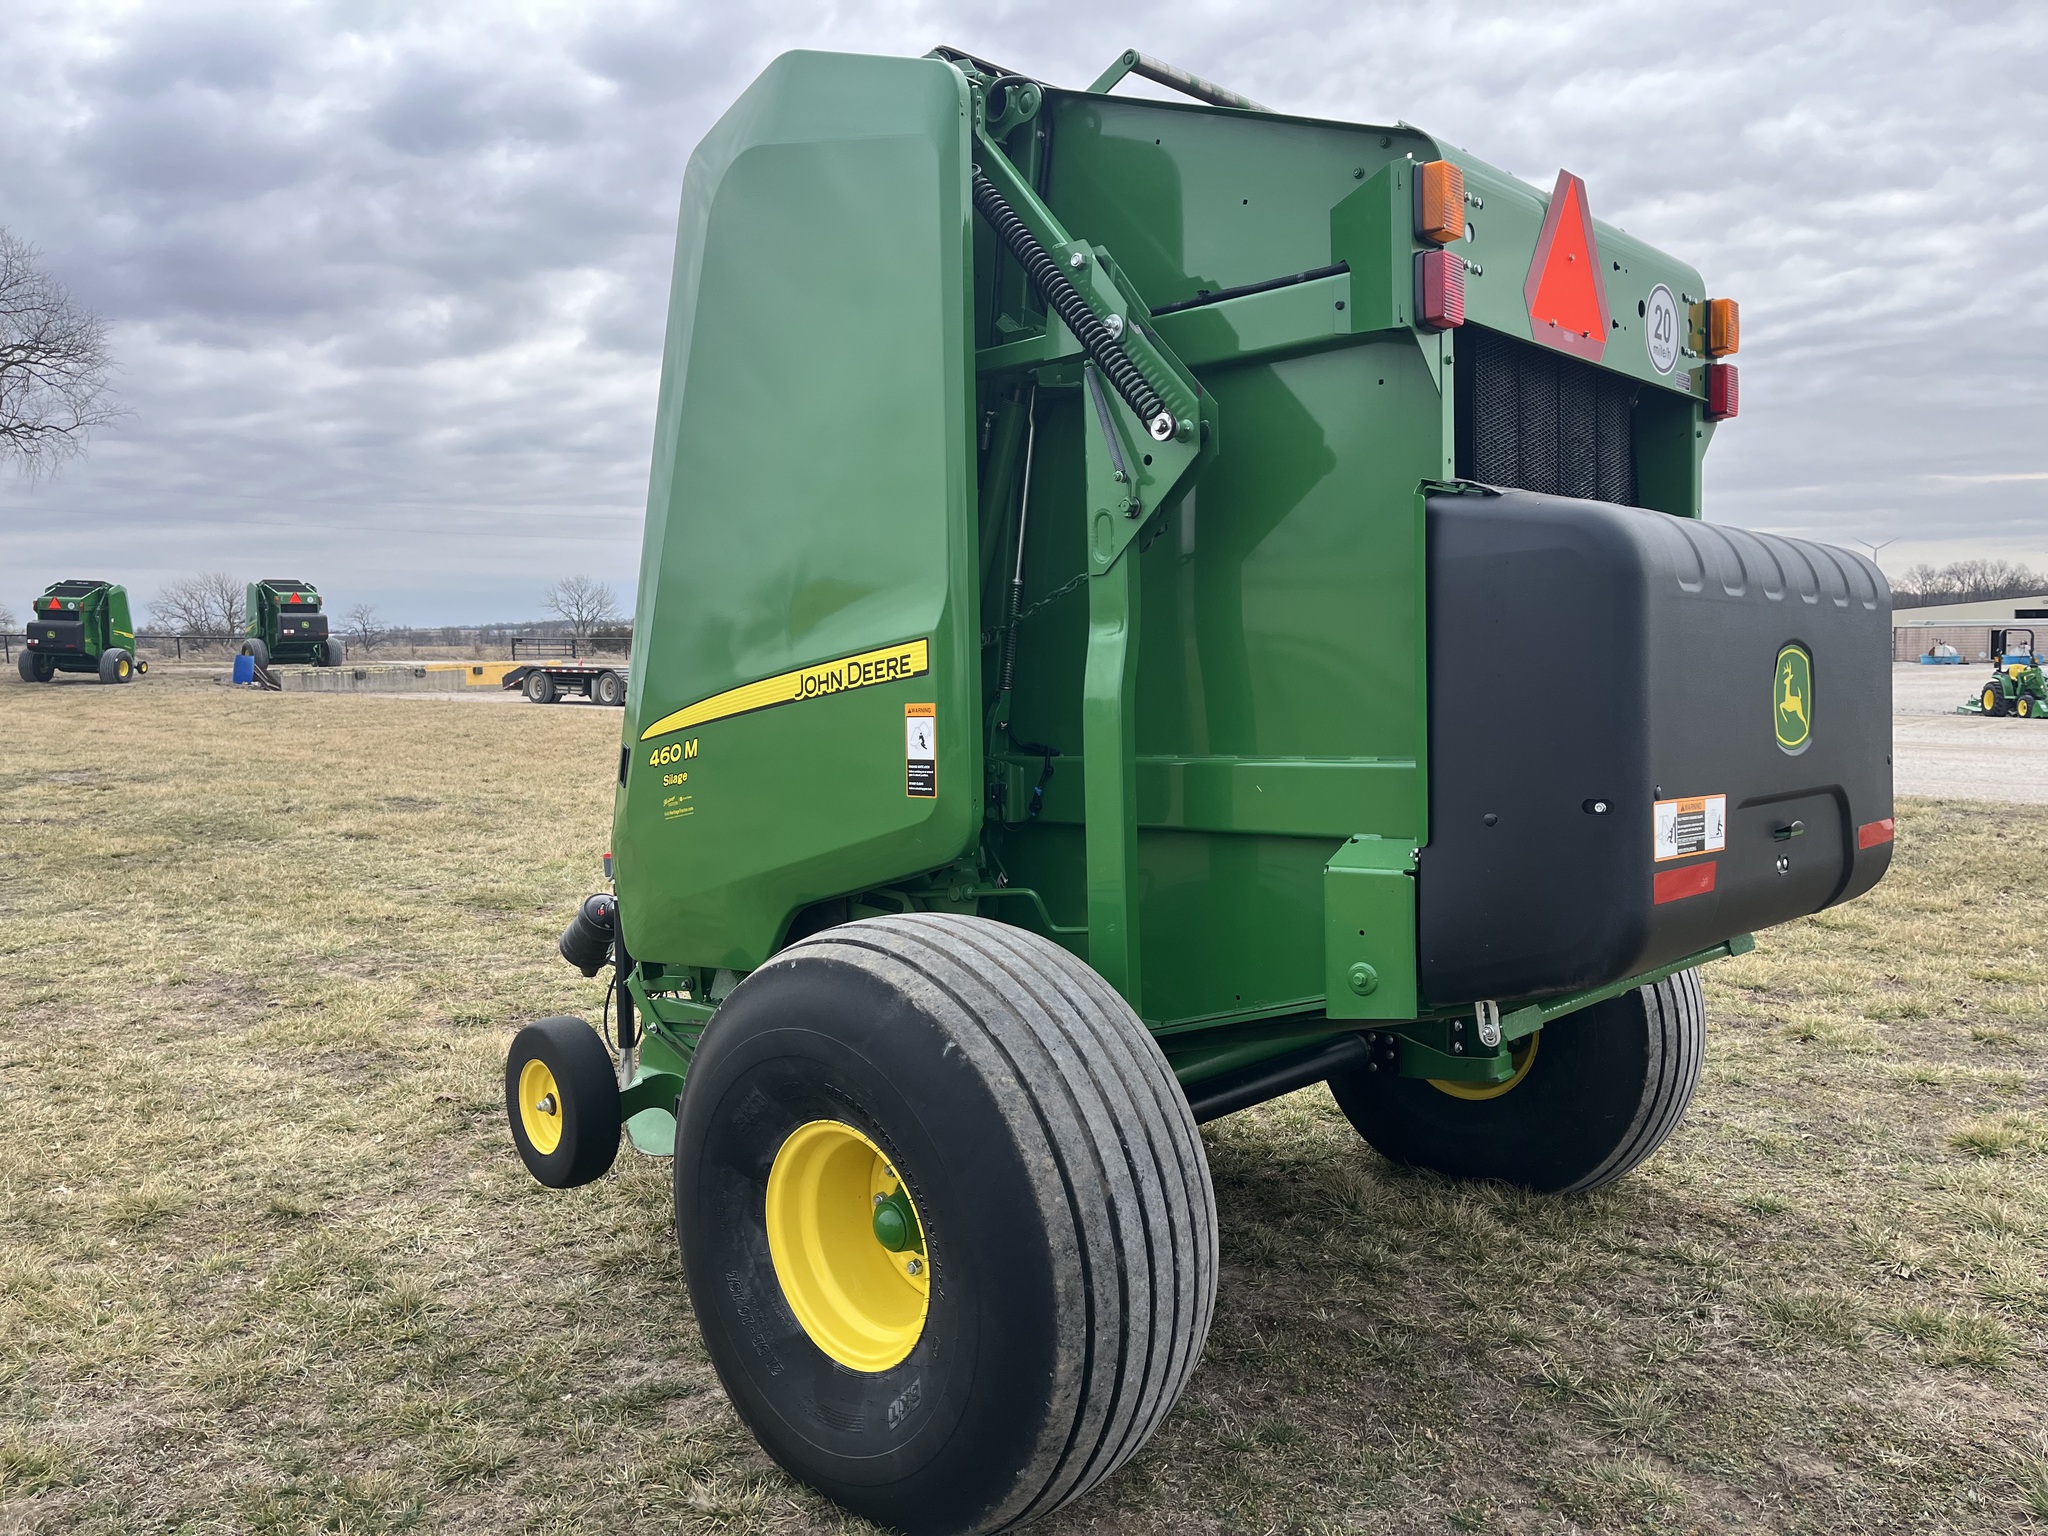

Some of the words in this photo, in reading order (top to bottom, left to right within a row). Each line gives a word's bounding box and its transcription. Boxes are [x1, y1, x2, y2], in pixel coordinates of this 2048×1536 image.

[1653, 304, 1671, 343] 20
[794, 668, 843, 698] JOHN
[847, 653, 911, 685] DEERE
[649, 742, 682, 768] 460
[684, 737, 699, 760] M
[663, 771, 688, 787] Silage
